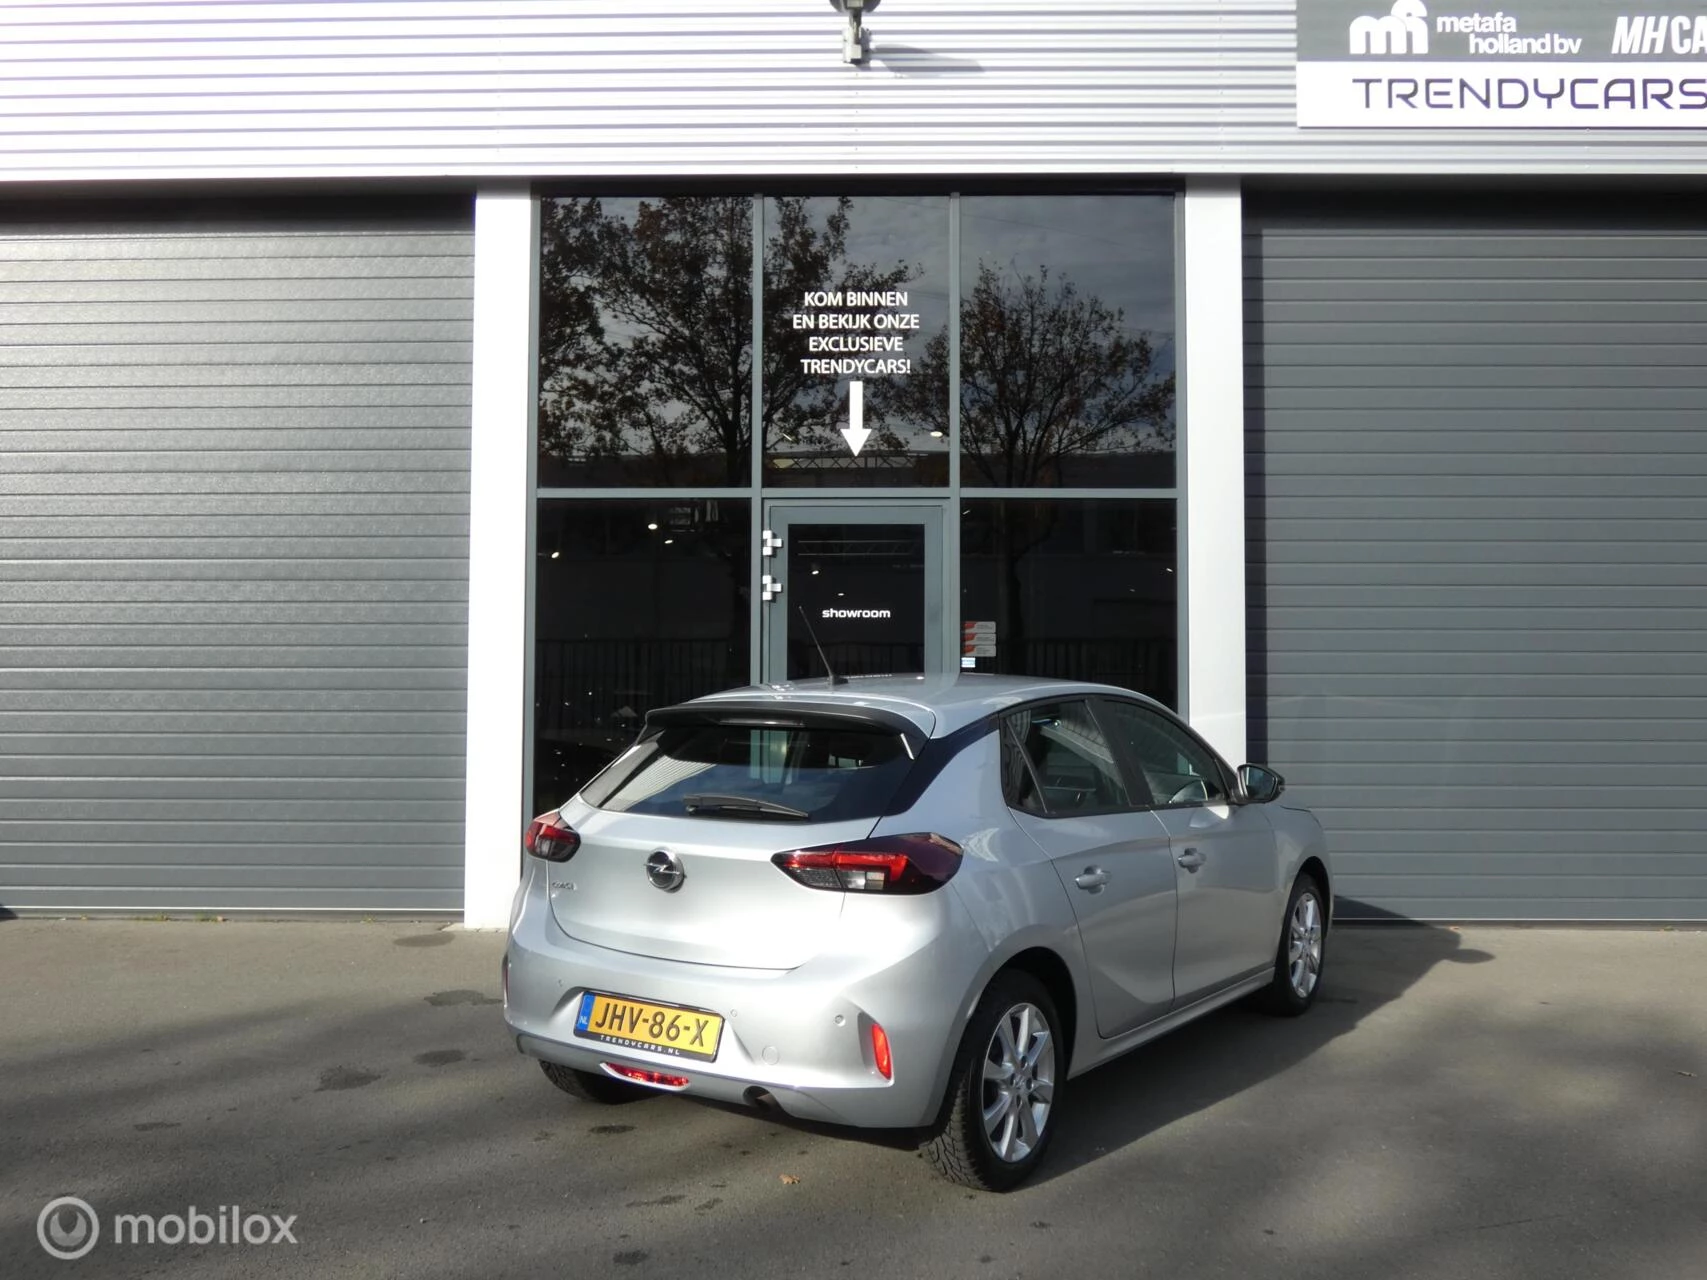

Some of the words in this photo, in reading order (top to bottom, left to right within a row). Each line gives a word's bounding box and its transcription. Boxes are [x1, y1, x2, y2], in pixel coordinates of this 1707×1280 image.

[1436, 12, 1517, 33] metafa
[1352, 78, 1707, 109] TRENDYCARS
[804, 291, 843, 306] KOM
[846, 291, 908, 306] BINNEN
[793, 314, 814, 329] EN
[818, 314, 871, 329] BEKIJK
[874, 314, 920, 329] ONZE
[809, 337, 903, 351] EXCLUSIEVE
[800, 359, 911, 374] TRENDYCARS!
[822, 608, 891, 618] showroom
[595, 1003, 709, 1047] JHV-86-X
[600, 1034, 680, 1056] TRENDYCARS.NL
